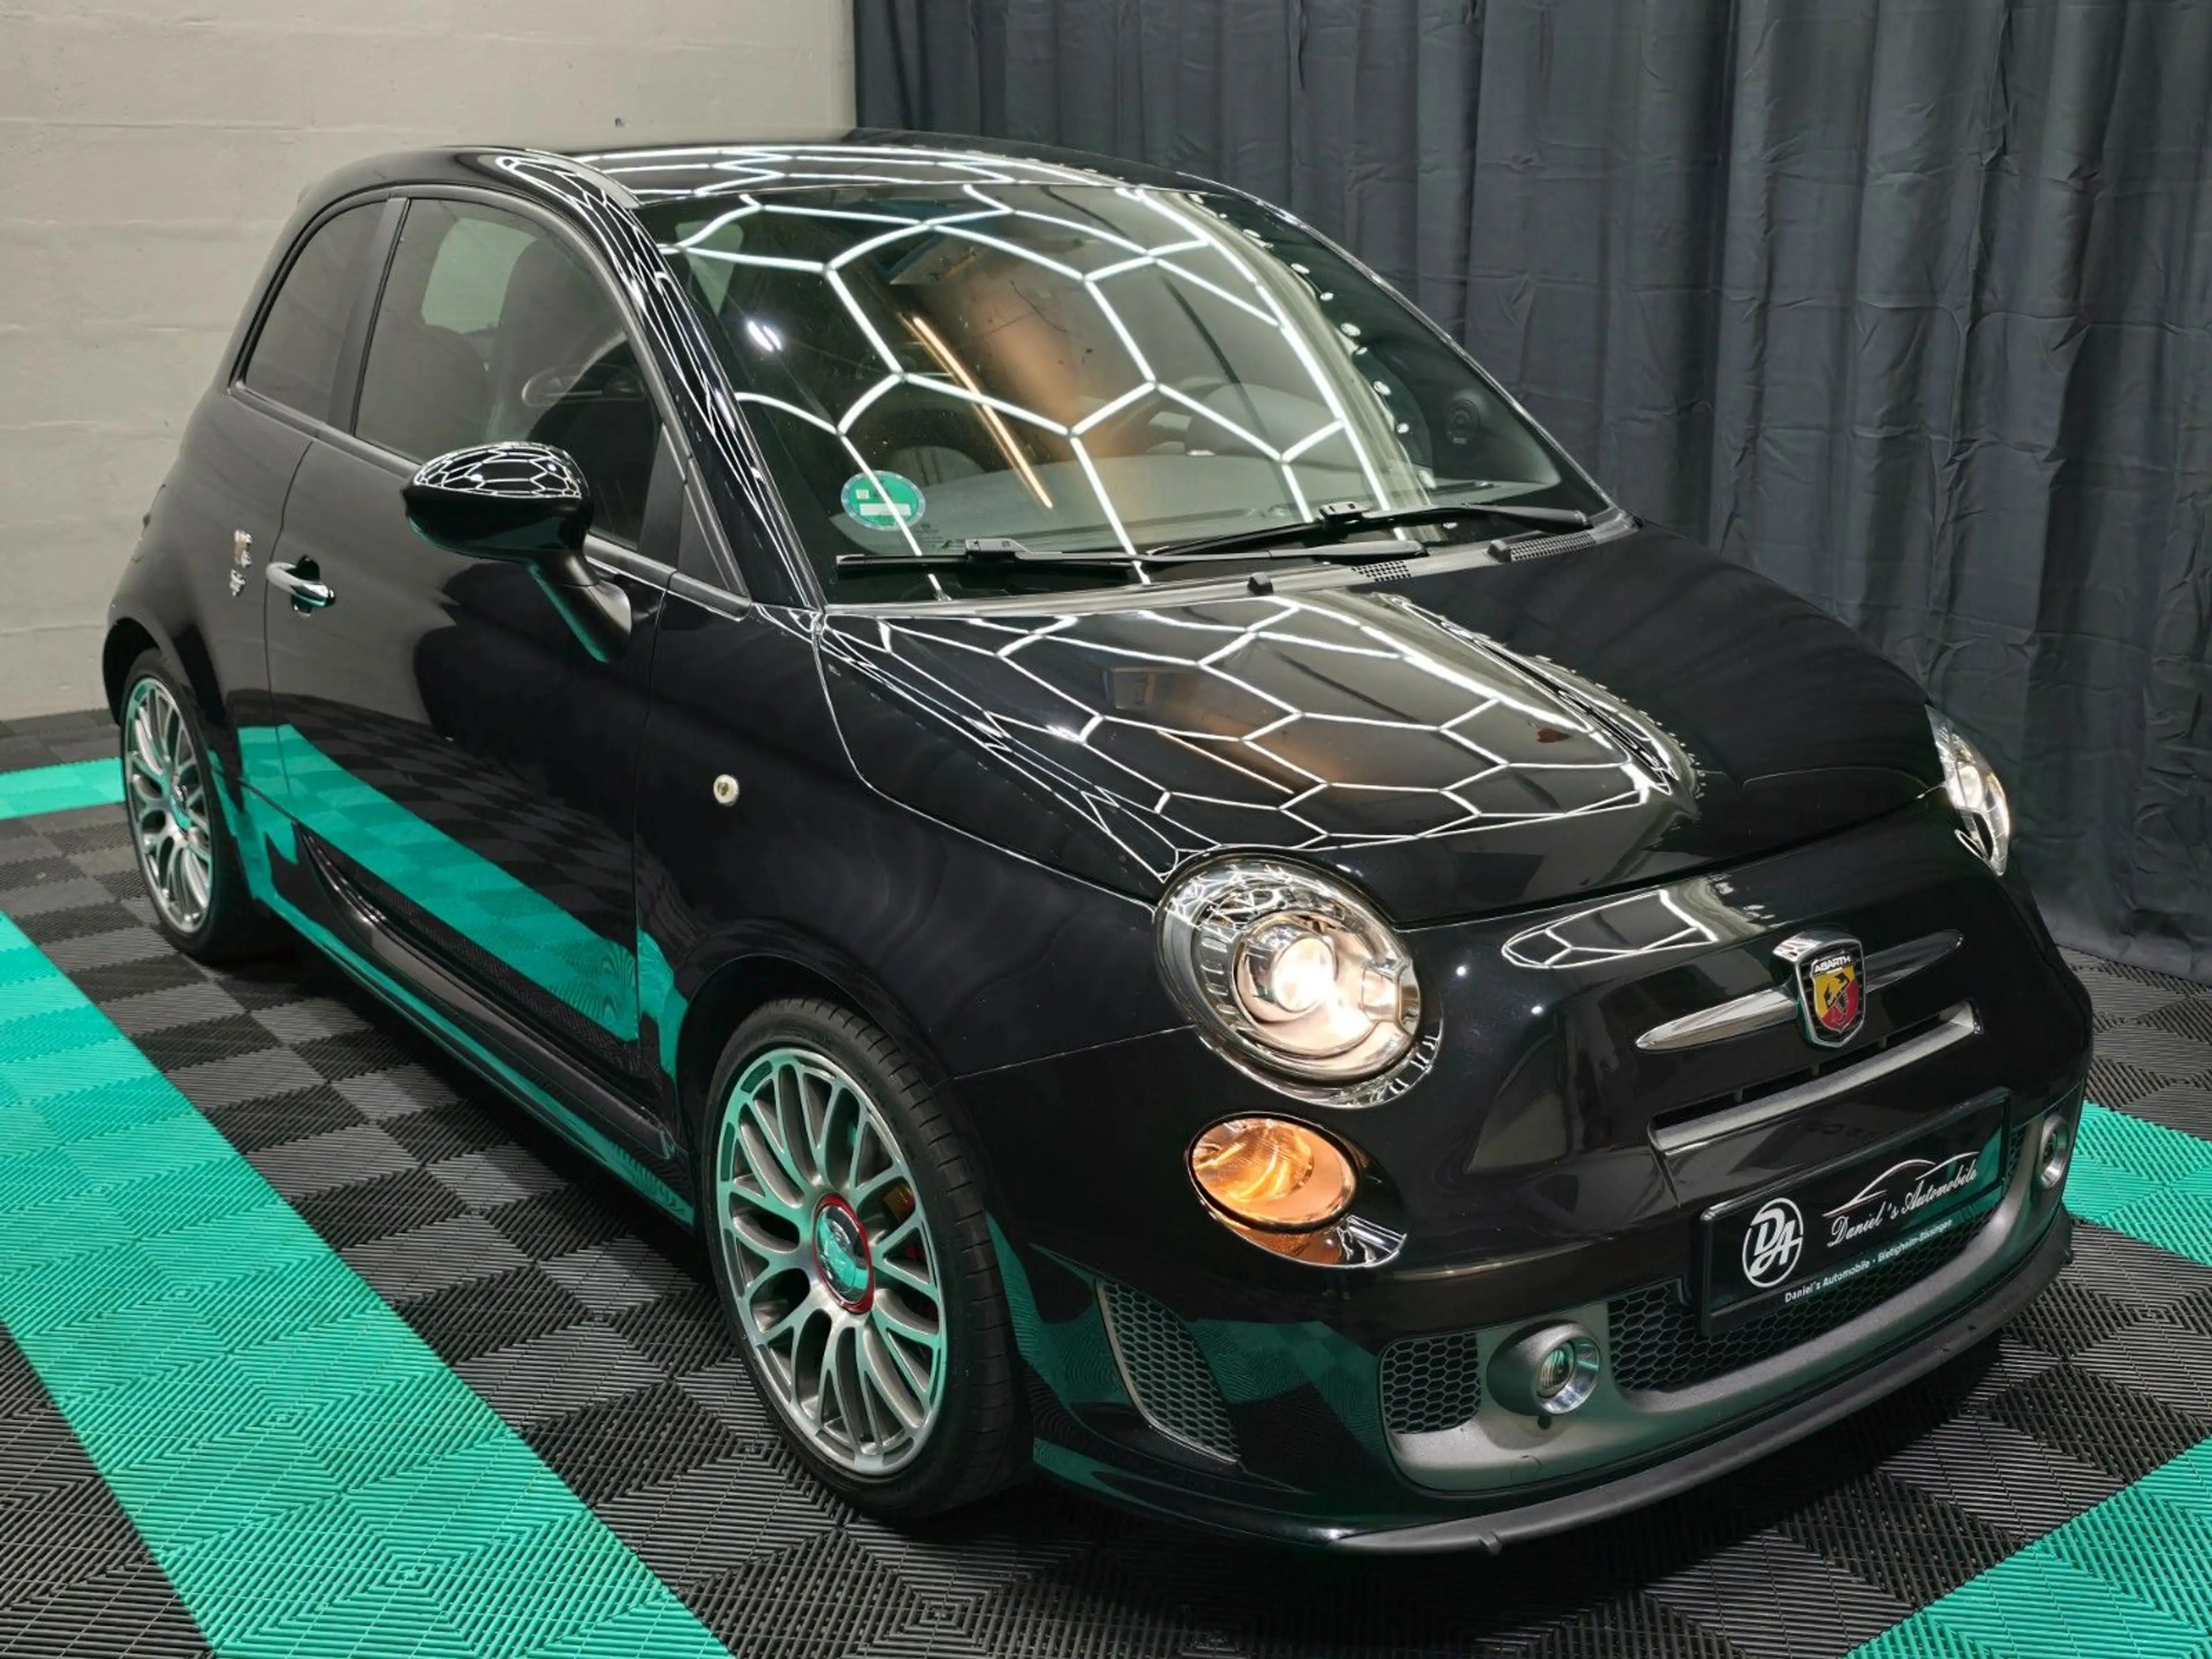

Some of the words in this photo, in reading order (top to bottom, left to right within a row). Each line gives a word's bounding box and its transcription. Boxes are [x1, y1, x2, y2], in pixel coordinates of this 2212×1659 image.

[1815, 955, 1851, 972] ABARTH
[1901, 1158, 1978, 1215] Automobile
[1821, 1260, 1870, 1286] Automobile
